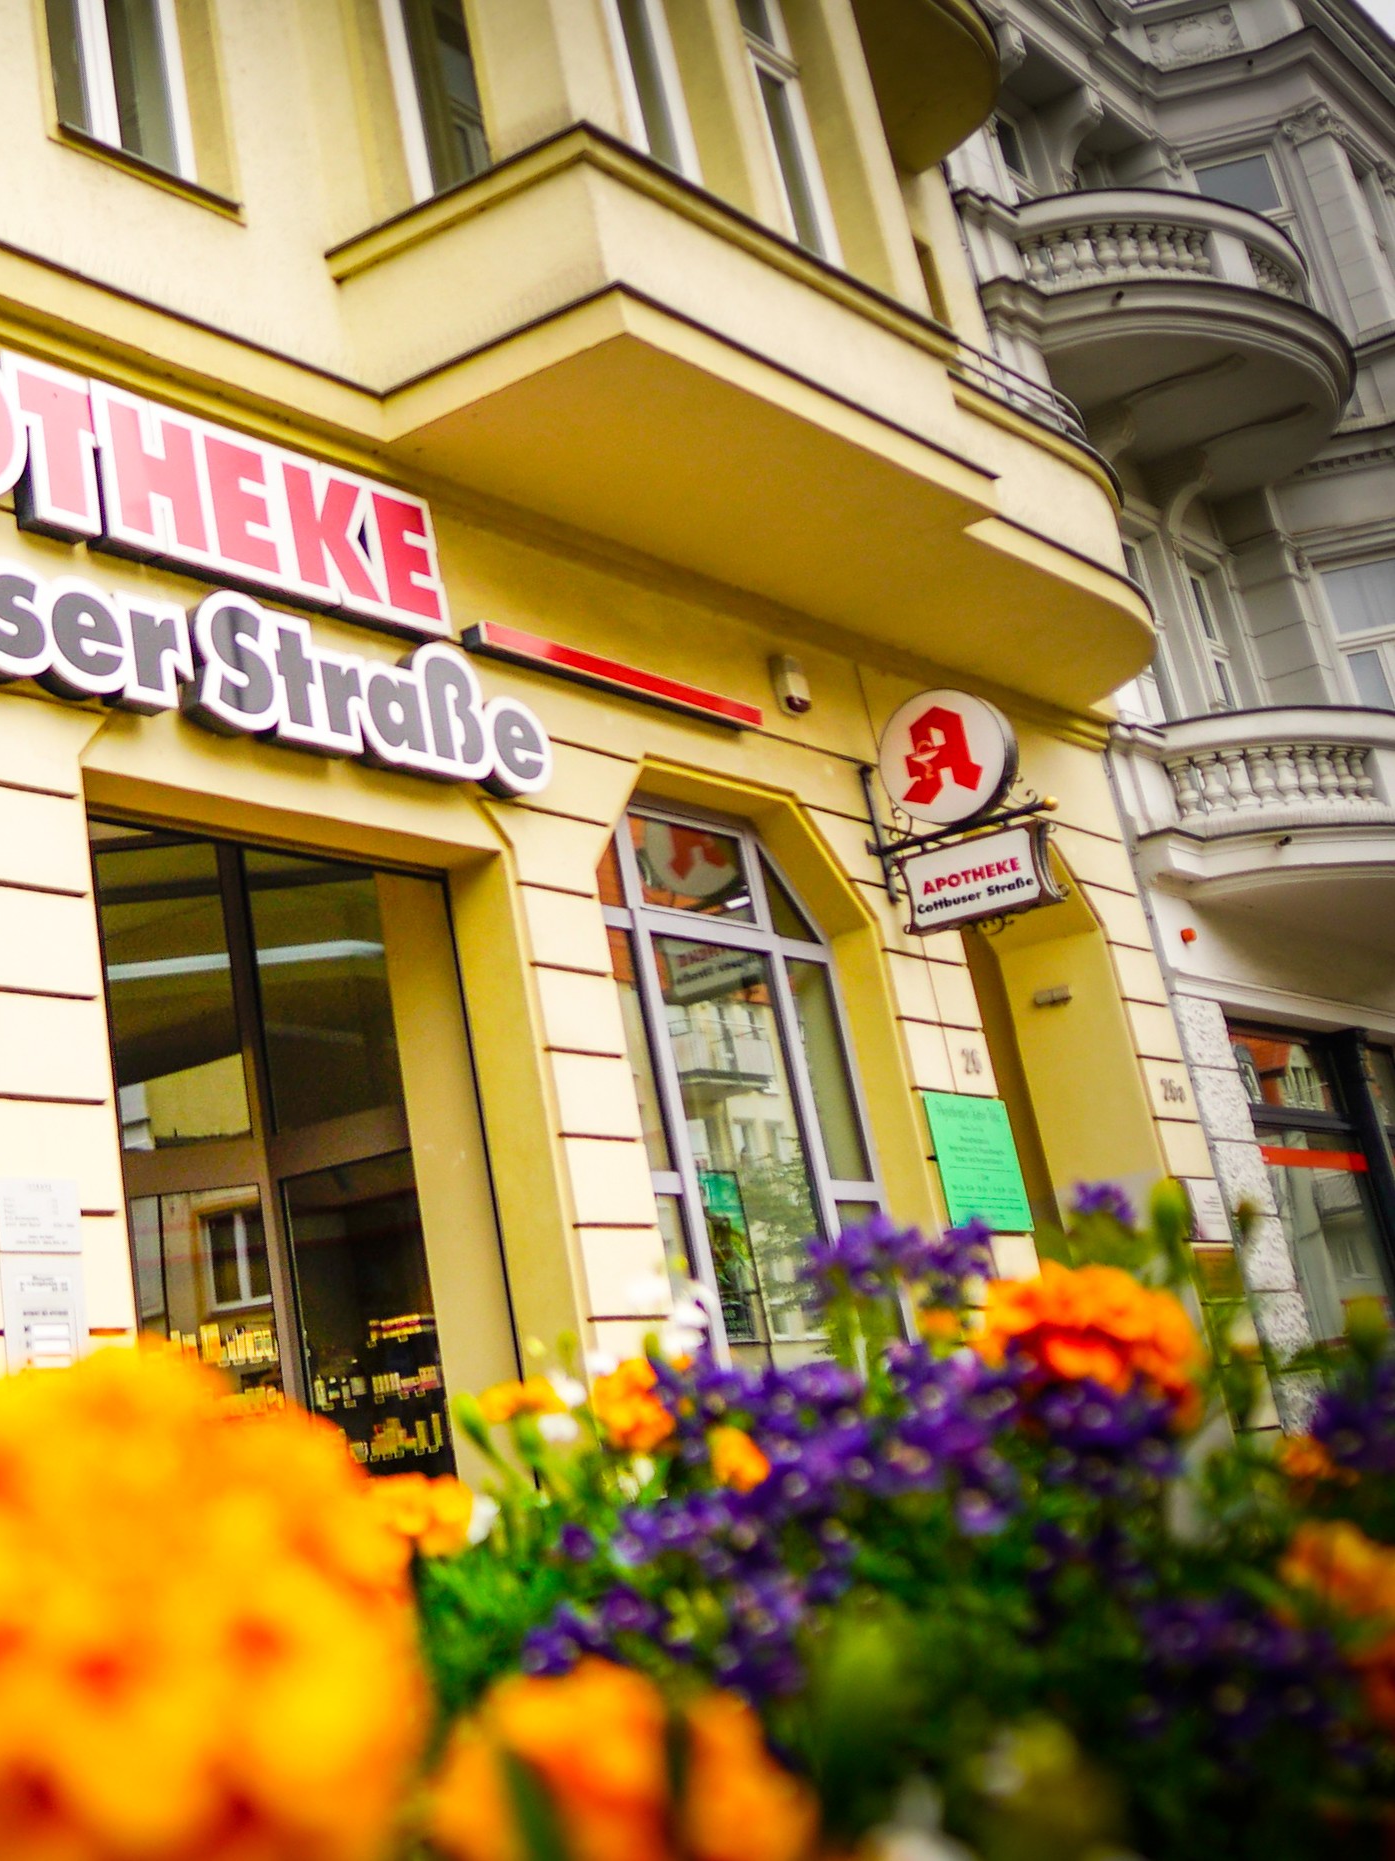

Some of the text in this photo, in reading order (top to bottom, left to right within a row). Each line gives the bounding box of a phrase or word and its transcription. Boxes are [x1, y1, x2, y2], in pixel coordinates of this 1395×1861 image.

[216, 606, 545, 783] Straße
[916, 876, 1034, 915] Cottbuser Straße
[923, 857, 1021, 896] APOTHEKE
